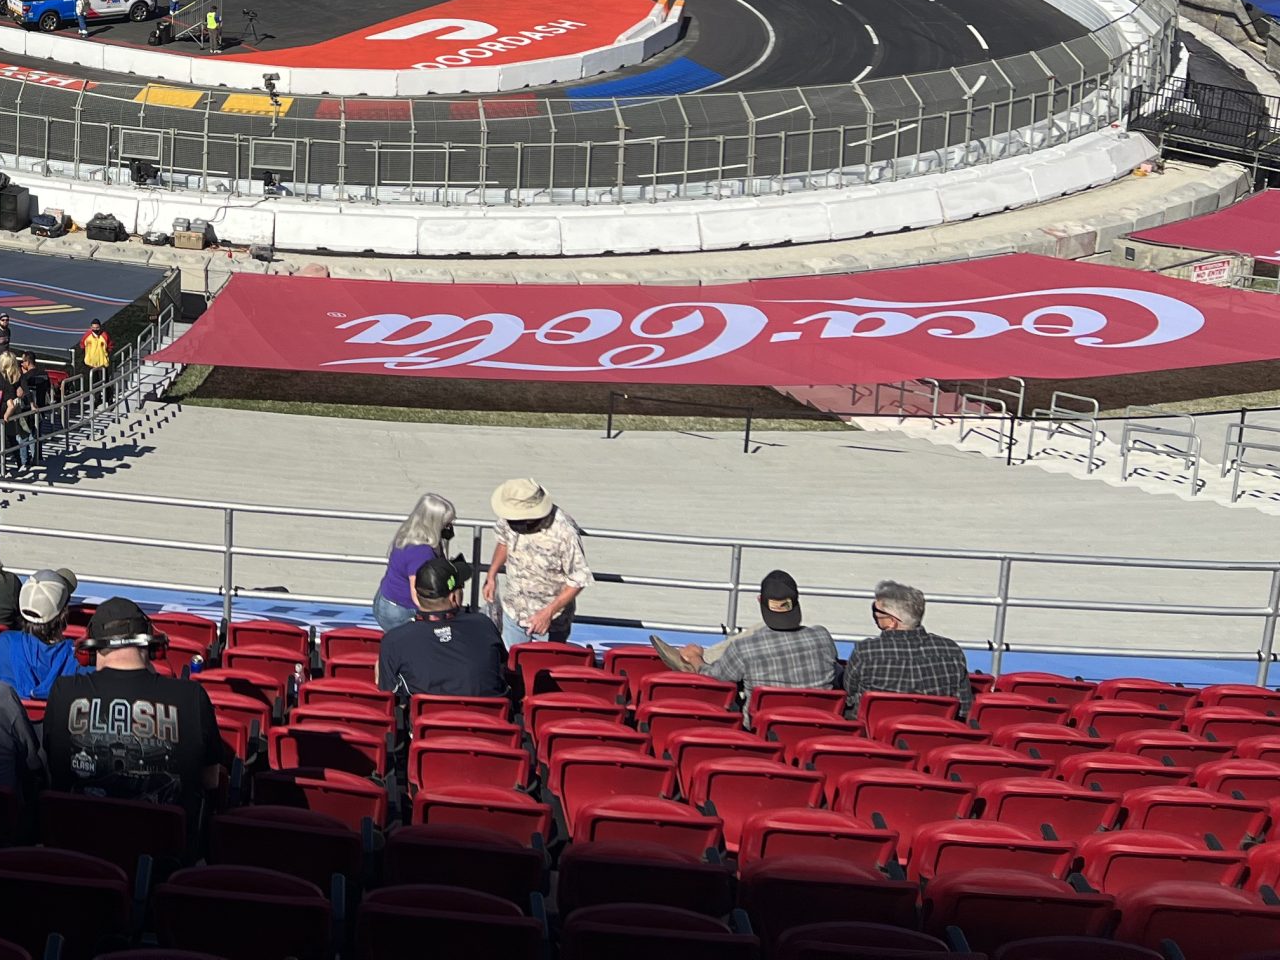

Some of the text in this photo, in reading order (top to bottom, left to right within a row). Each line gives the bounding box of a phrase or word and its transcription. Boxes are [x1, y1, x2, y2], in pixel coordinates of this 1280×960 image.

[412, 19, 588, 70] DOORDASH
[1196, 271, 1206, 279] NO
[1207, 268, 1227, 278] ENTRY
[319, 286, 1206, 371] Coca-Cola
[68, 697, 180, 744] CLASH
[72, 759, 95, 772] CLASH
